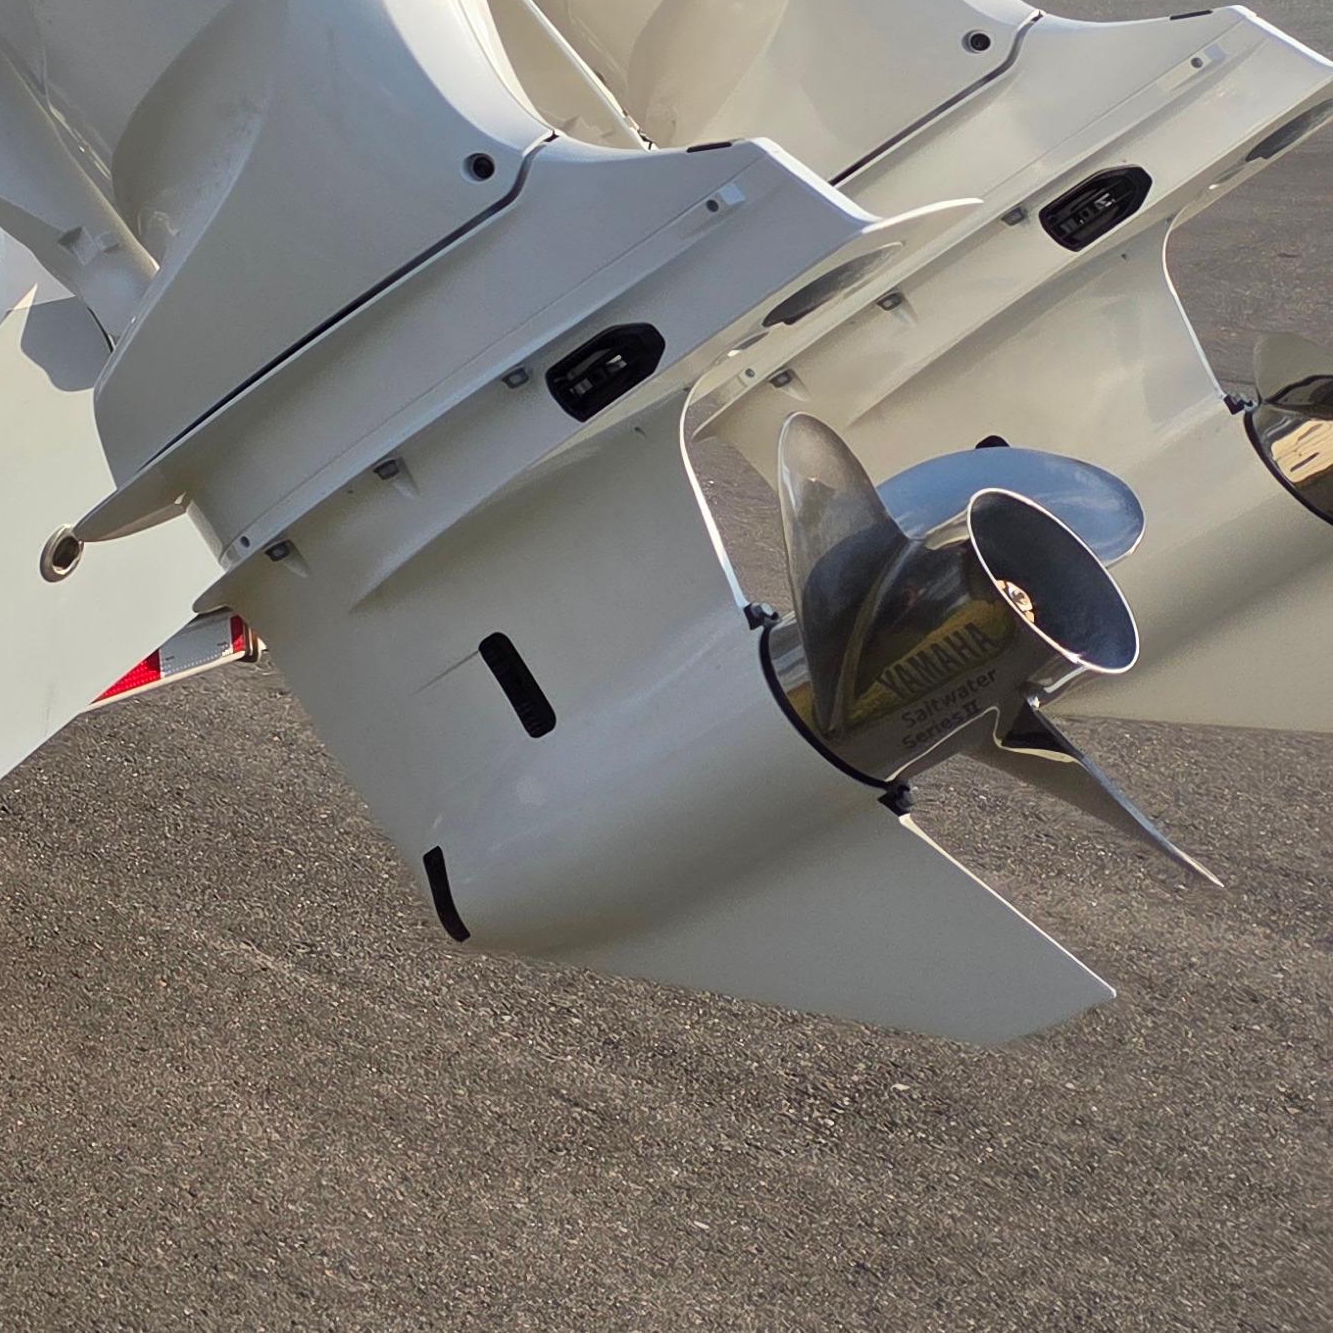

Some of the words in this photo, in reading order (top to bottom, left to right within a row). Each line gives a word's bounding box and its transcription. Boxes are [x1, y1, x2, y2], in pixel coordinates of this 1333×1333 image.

[876, 622, 998, 699] YAMAHA
[900, 668, 997, 729] Saltwater
[902, 713, 964, 749] Series
